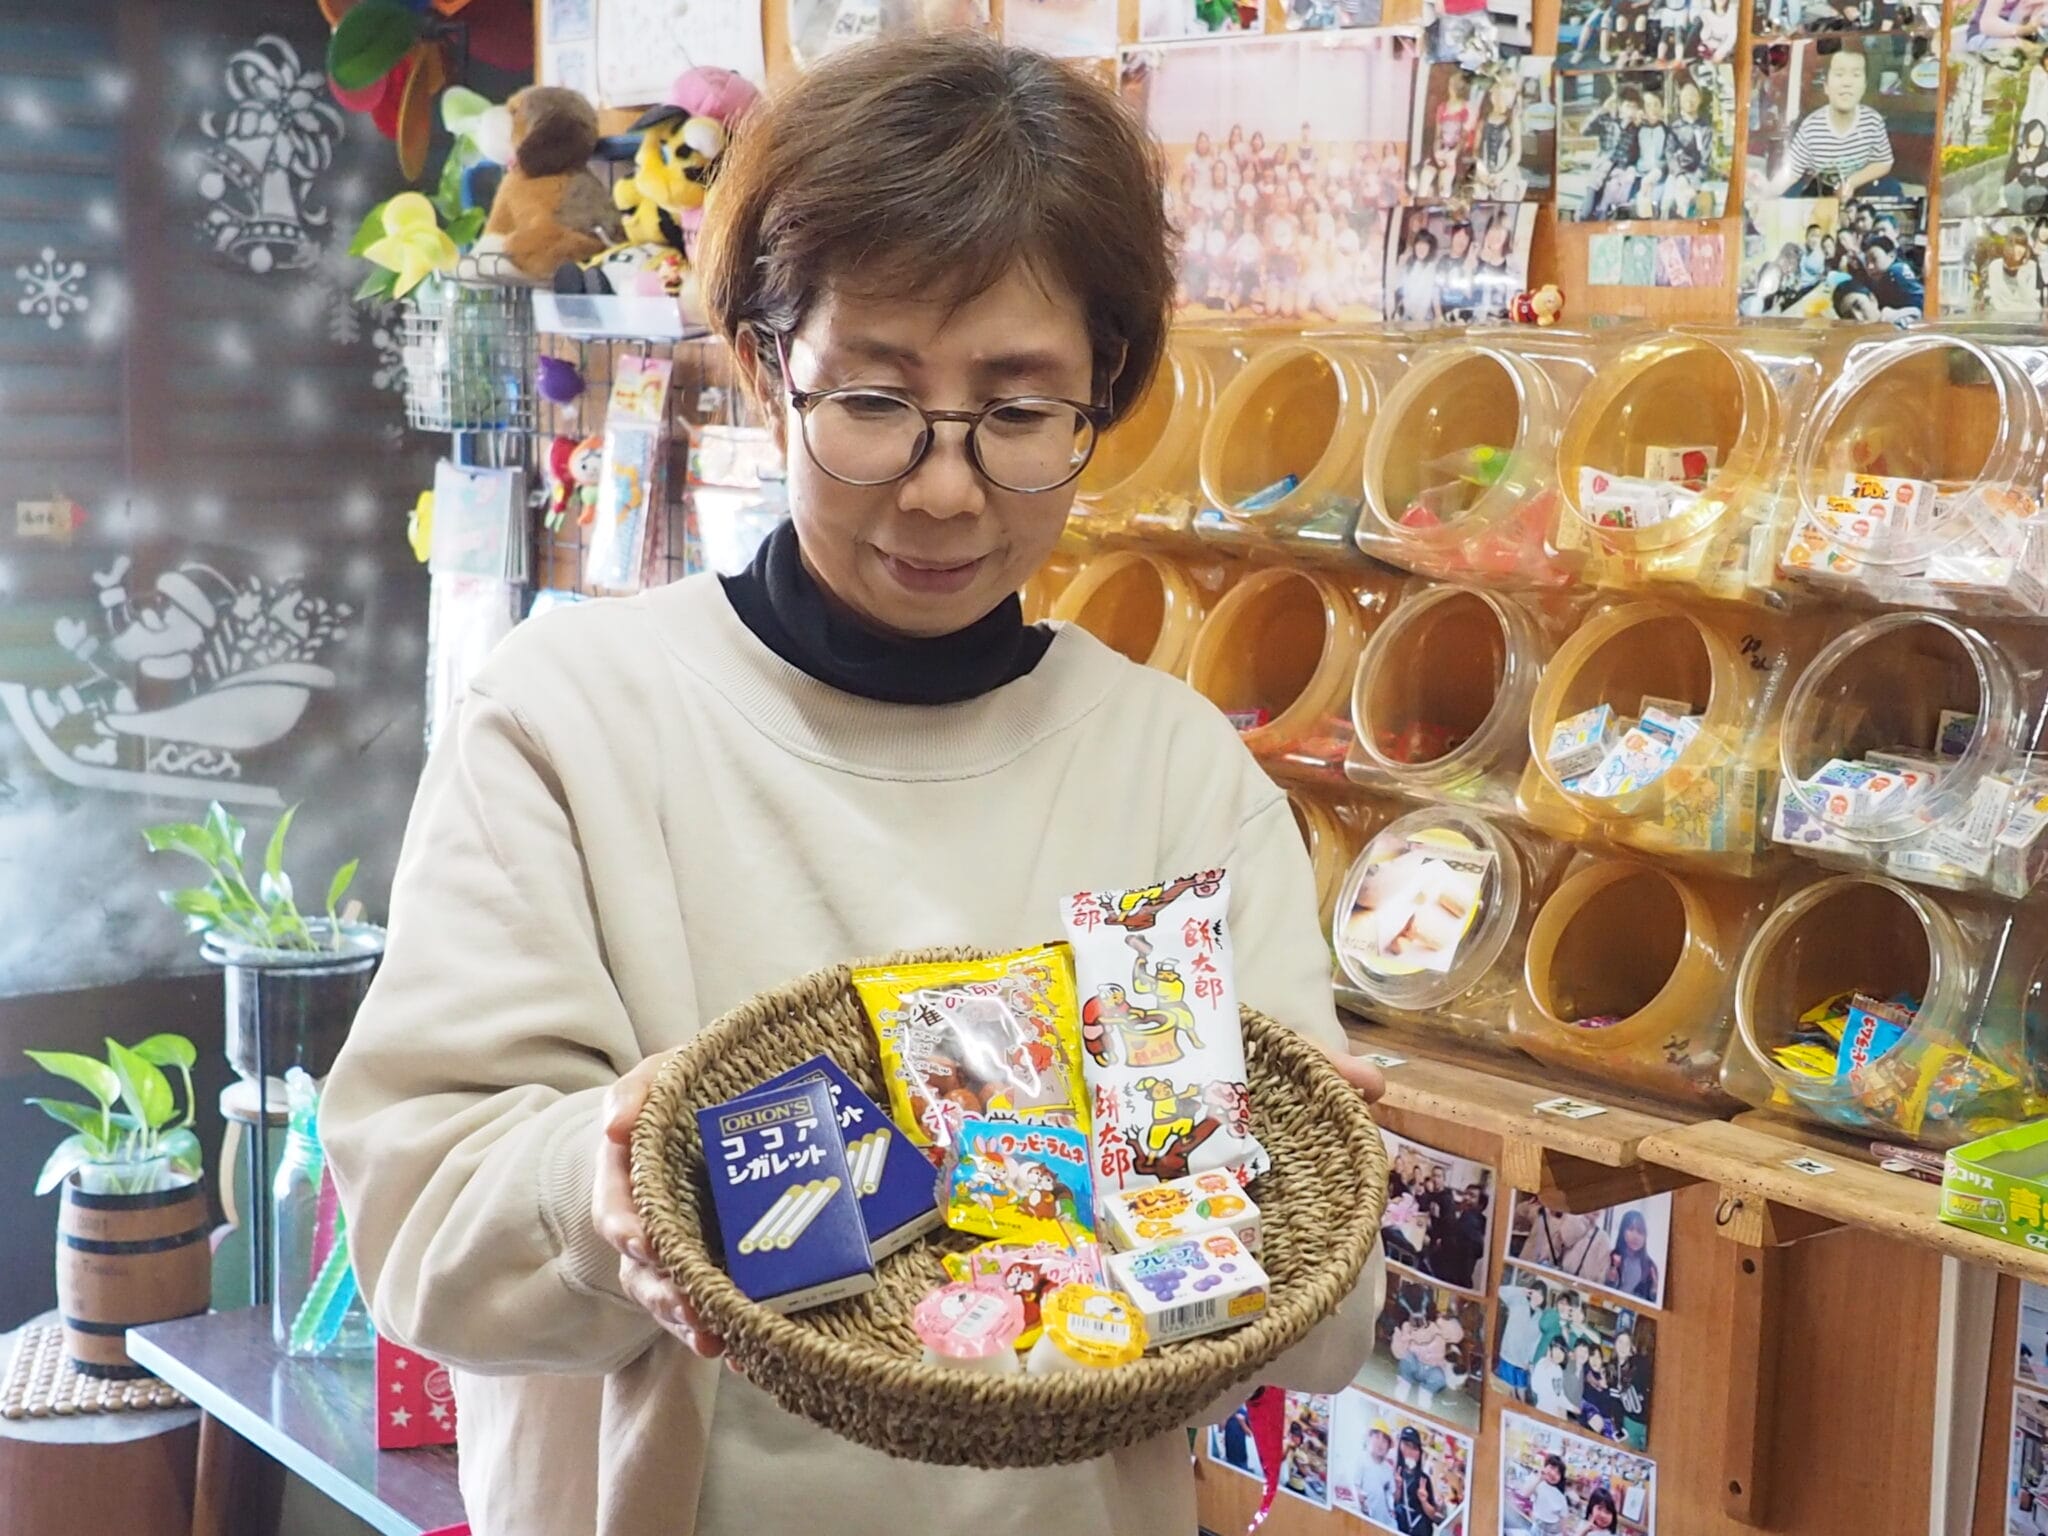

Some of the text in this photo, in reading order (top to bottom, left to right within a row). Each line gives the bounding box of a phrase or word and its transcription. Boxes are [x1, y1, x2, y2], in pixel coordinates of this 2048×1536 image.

[723, 1099, 810, 1132] ORION'S
[720, 1117, 818, 1161] ココア
[1001, 1133, 1085, 1164] クッピーラムネ
[726, 1144, 827, 1185] シガレット
